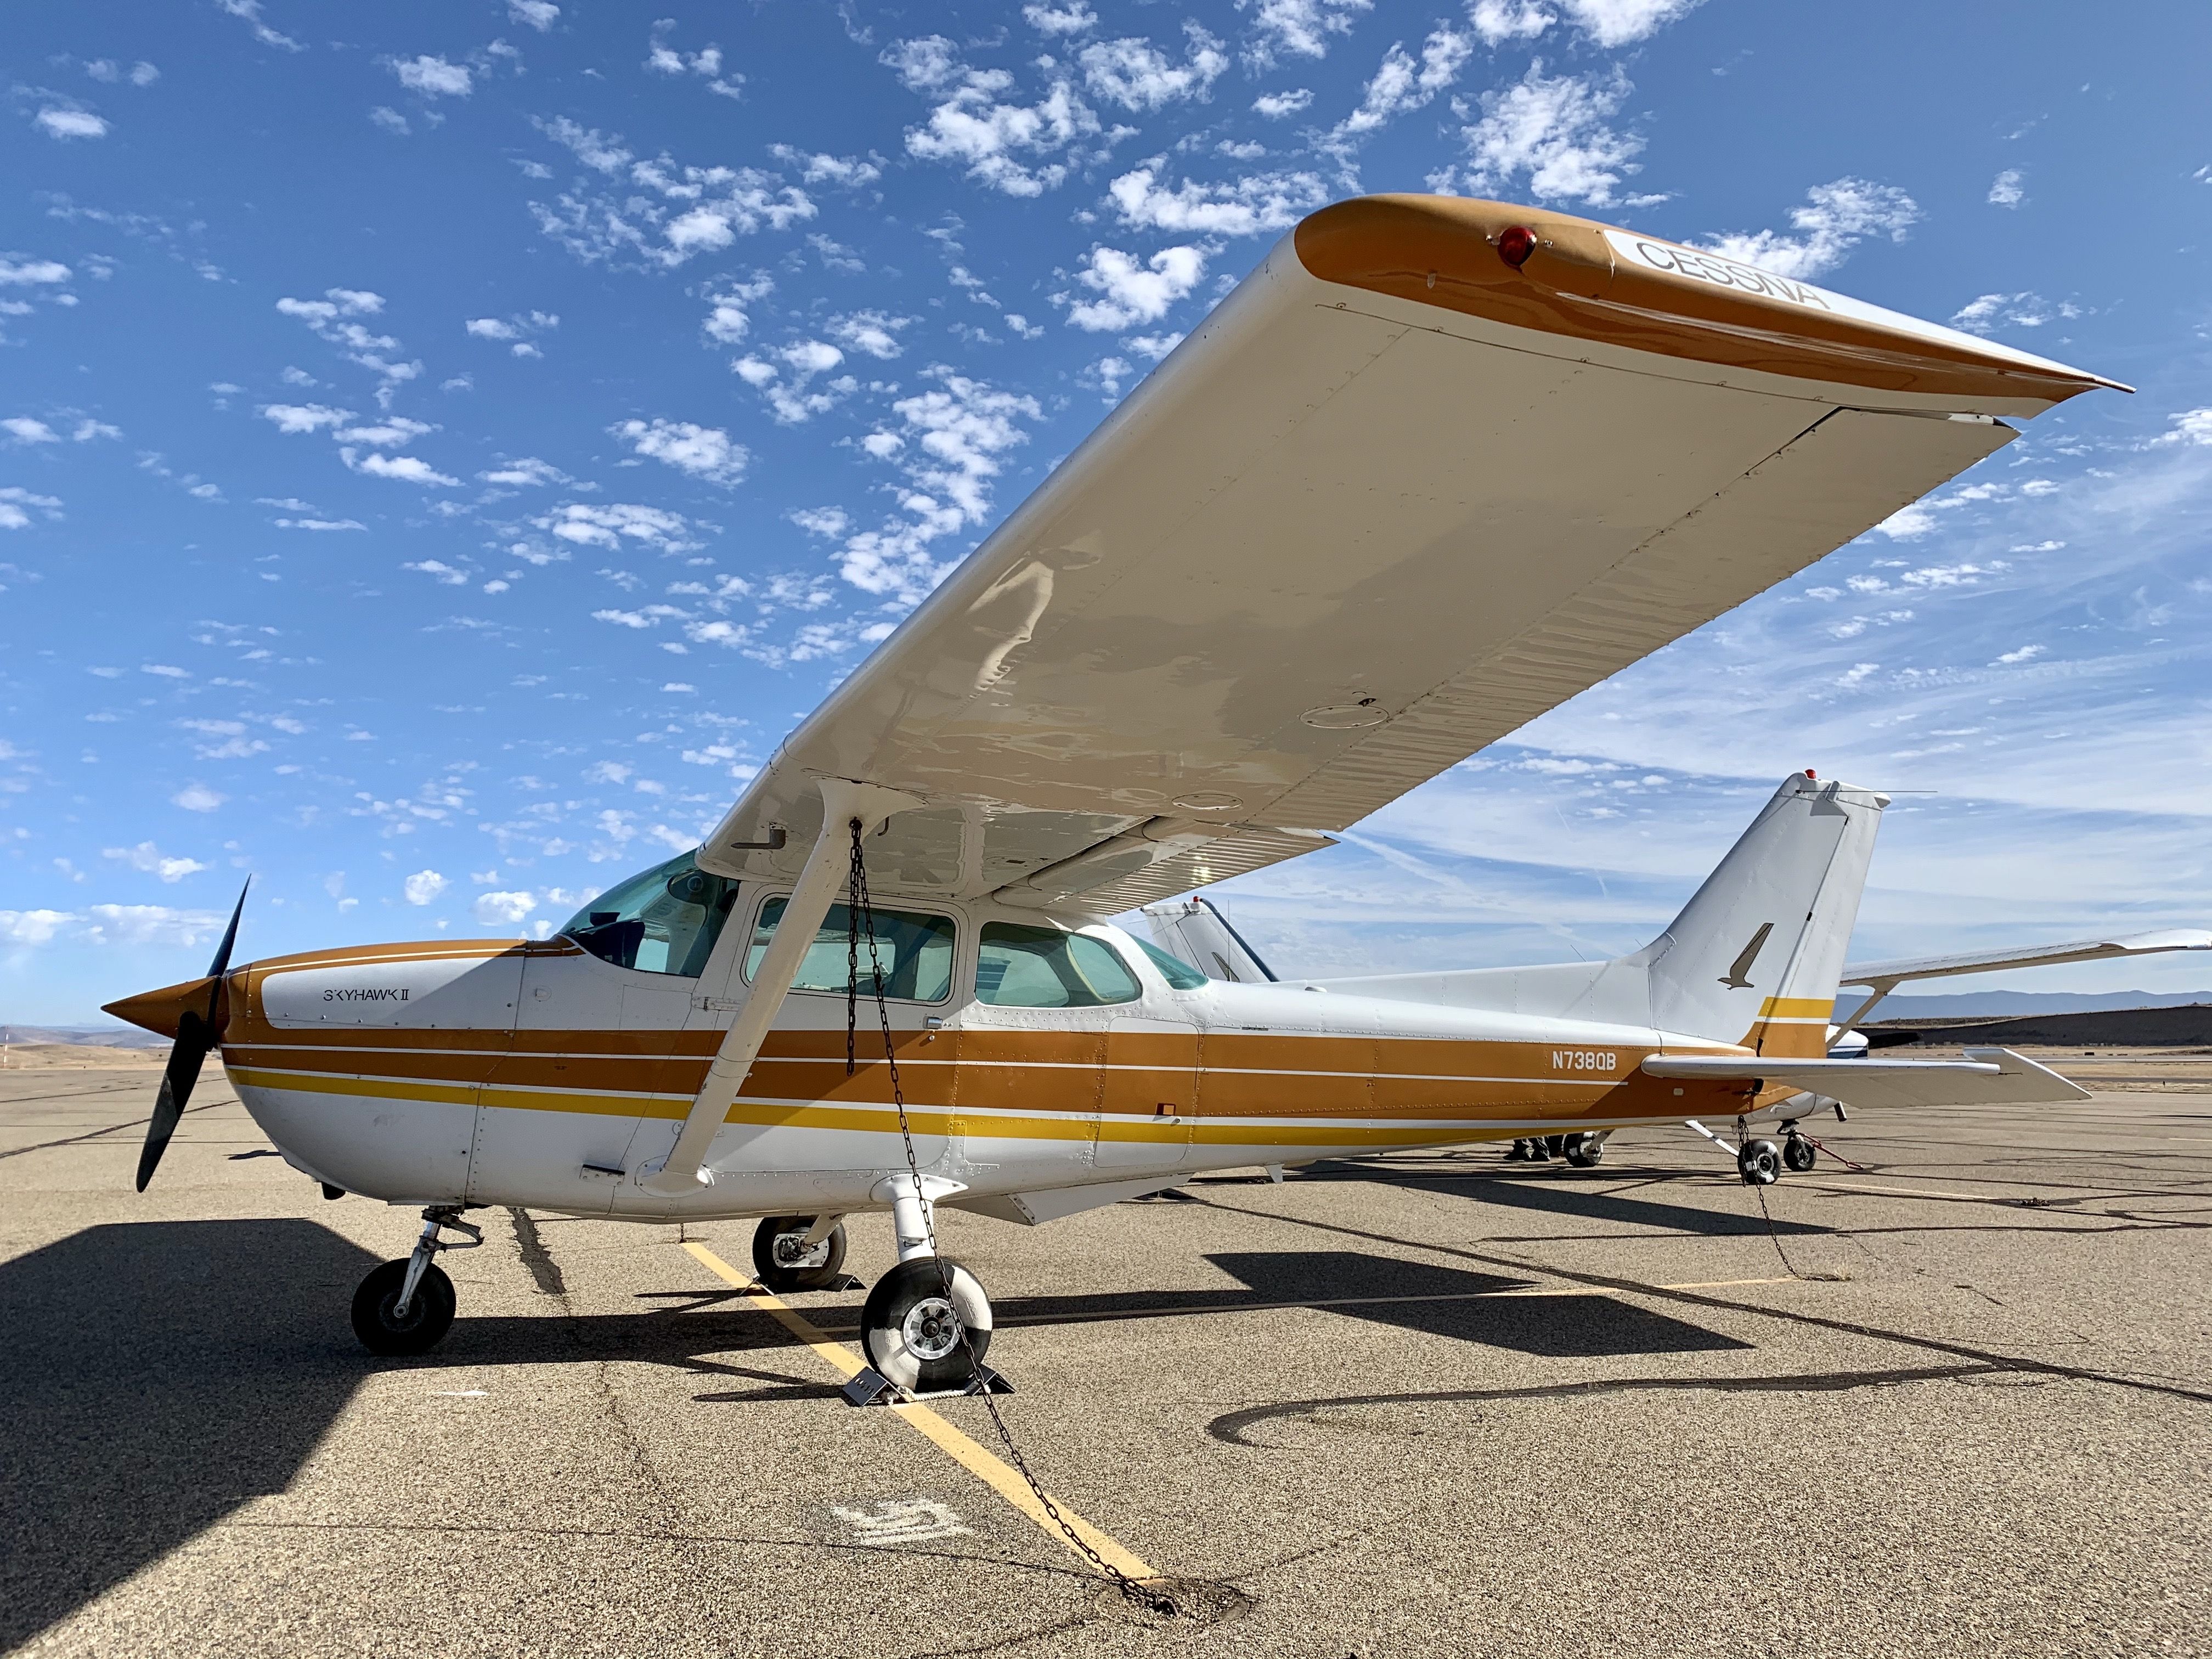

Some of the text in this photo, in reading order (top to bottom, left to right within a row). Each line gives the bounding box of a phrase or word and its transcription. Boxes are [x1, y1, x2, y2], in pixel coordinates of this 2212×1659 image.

[1637, 242, 1831, 309] CESSNA
[323, 989, 410, 1001] SKYHAWK II
[1553, 1051, 1616, 1071] N738QB
